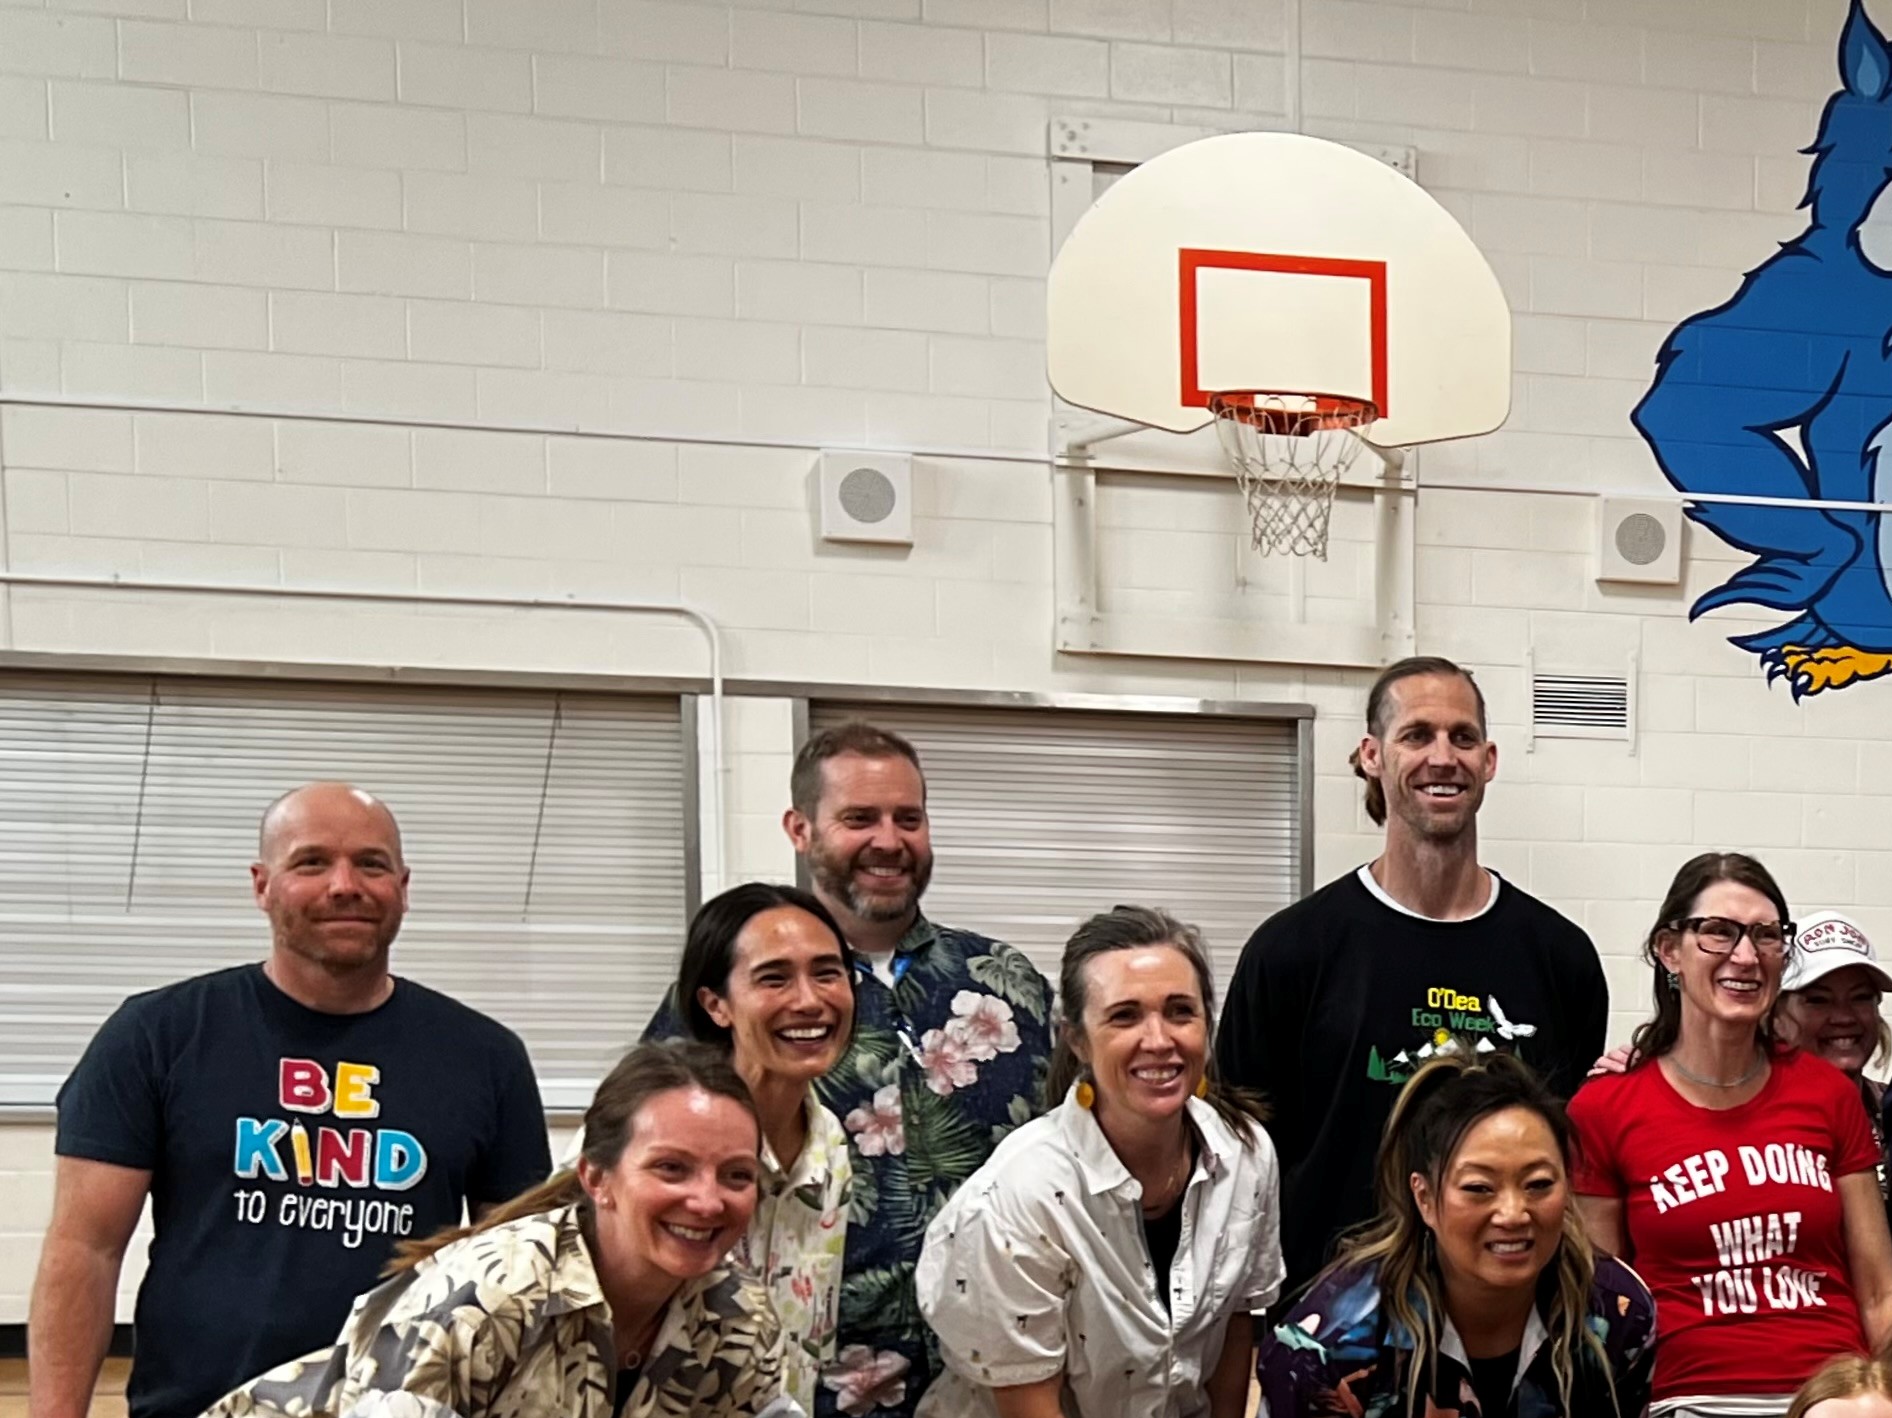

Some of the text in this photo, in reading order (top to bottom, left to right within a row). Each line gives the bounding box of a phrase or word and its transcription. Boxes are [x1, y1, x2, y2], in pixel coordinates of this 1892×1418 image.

[1803, 923, 1836, 945] RON
[1411, 1008, 1496, 1034] Eco Week
[1427, 987, 1482, 1012] O'Dea
[279, 1057, 381, 1119] BE
[234, 1117, 428, 1191] KIND
[1650, 1143, 1833, 1214] KEEP DOING
[234, 1189, 414, 1249] to everyone
[1709, 1211, 1802, 1267] WHAT
[1691, 1265, 1827, 1316] YOU LOVE
